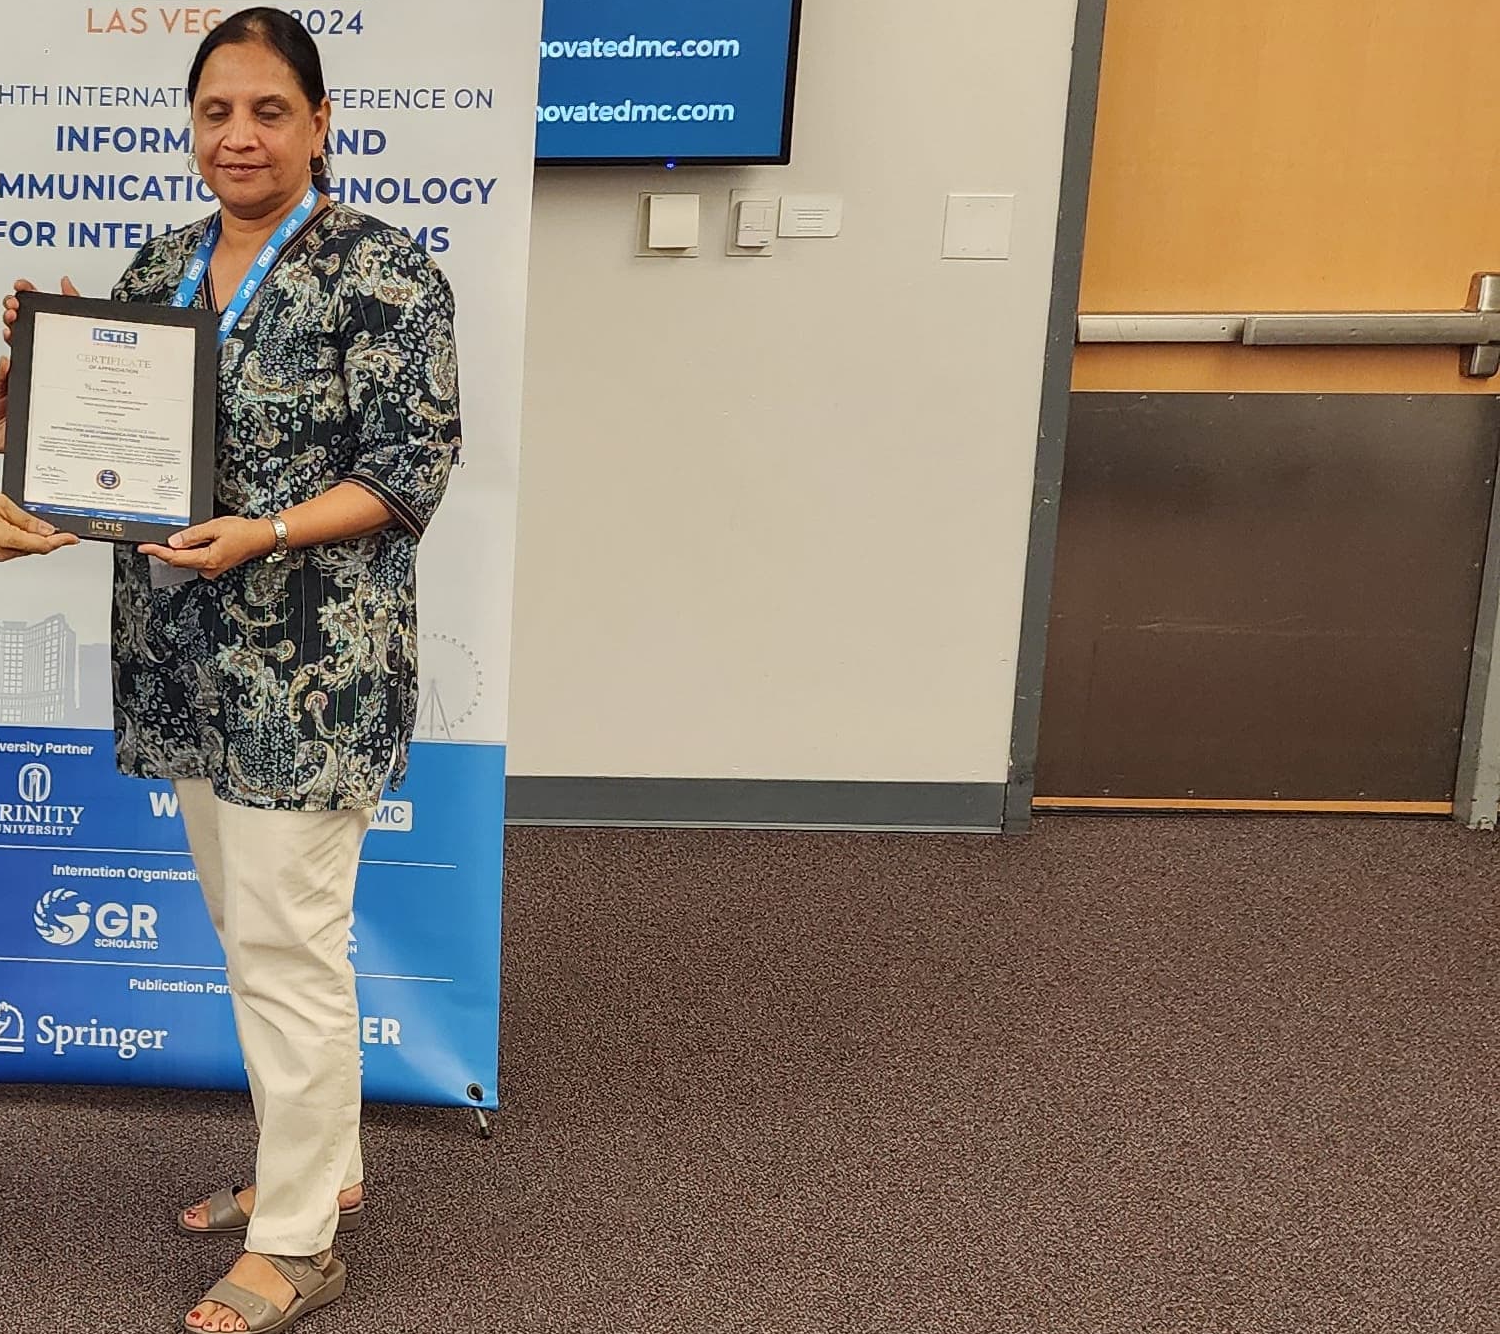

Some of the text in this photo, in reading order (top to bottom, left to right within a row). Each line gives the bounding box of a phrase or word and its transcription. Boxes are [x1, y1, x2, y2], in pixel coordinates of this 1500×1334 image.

[87, 8, 148, 34] LAS
[159, 8, 222, 35] VEG
[540, 35, 740, 58] novatedmc.com
[58, 85, 189, 108] INTERNATI
[329, 88, 446, 109] FERENCE
[454, 88, 493, 109] ON
[536, 100, 735, 122] novatedmc.com
[56, 125, 191, 154] INFORM
[325, 178, 498, 204] HNOLOGY
[94, 329, 135, 343] ICTIS
[76, 353, 153, 369] CERTIFICATE
[91, 520, 123, 532] ICTIS
[45, 742, 94, 756] Partner
[371, 806, 405, 824] MC
[53, 865, 198, 882] Internation Organizati
[94, 902, 158, 939] GR
[94, 938, 159, 950] SCHOLASTIC
[129, 978, 204, 993] Publication
[36, 1015, 168, 1059] Springer
[362, 1017, 401, 1045] ER
